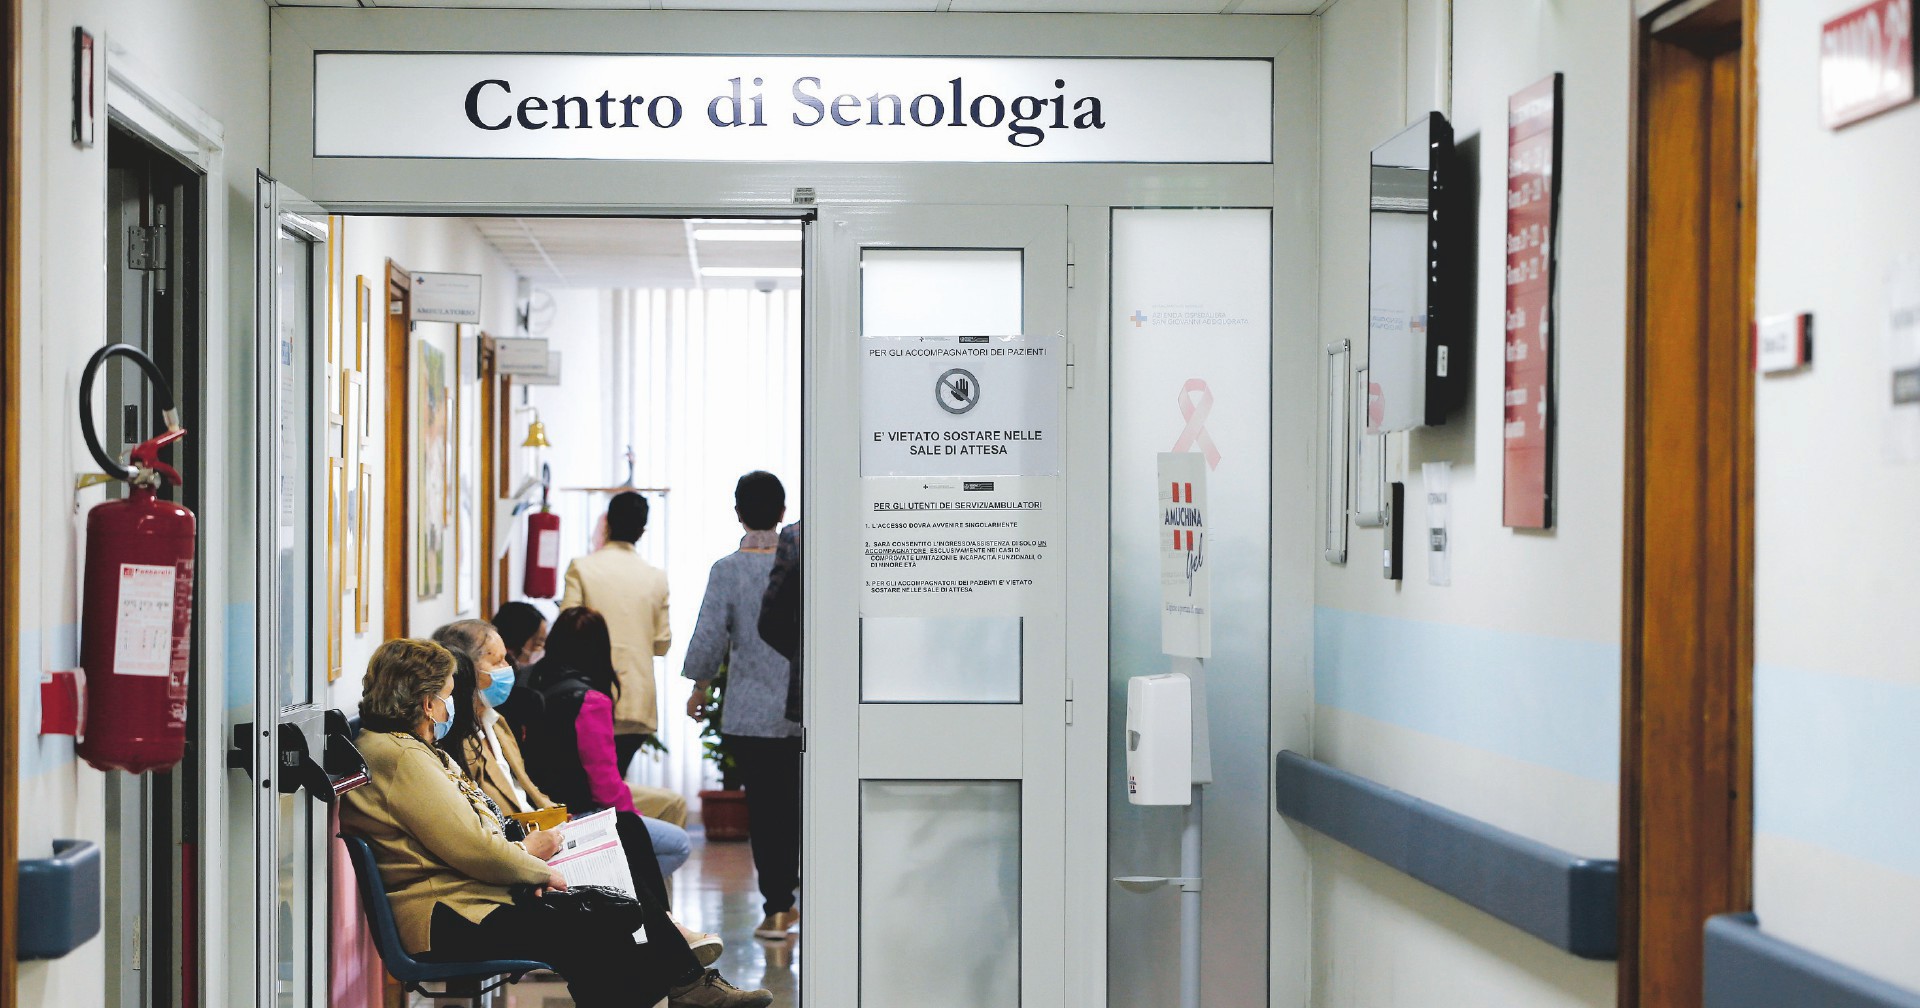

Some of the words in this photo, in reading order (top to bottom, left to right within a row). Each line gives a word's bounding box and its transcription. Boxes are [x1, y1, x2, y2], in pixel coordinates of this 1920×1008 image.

[465, 79, 683, 130] Centro
[707, 77, 768, 127] di
[791, 77, 1106, 148] Senologia
[416, 307, 476, 316] AMBULATORIO
[869, 349, 886, 357] PER
[889, 349, 903, 357] GLI
[905, 348, 988, 357] ACCOMPAGNATORI
[991, 348, 1005, 356] DEI
[1008, 348, 1047, 356] PAZIENTI
[874, 432, 885, 442] E'
[888, 431, 940, 442] VIETATO
[943, 431, 1000, 441] SOSTARE
[1004, 430, 1043, 441] NELLE
[910, 445, 941, 456] SALE
[945, 445, 956, 455] DI
[960, 445, 1008, 455] ATTESA
[874, 502, 890, 510] PER
[892, 502, 906, 510] GLI
[908, 502, 938, 510] UTENTI
[1165, 507, 1202, 527] AMUCHINA
